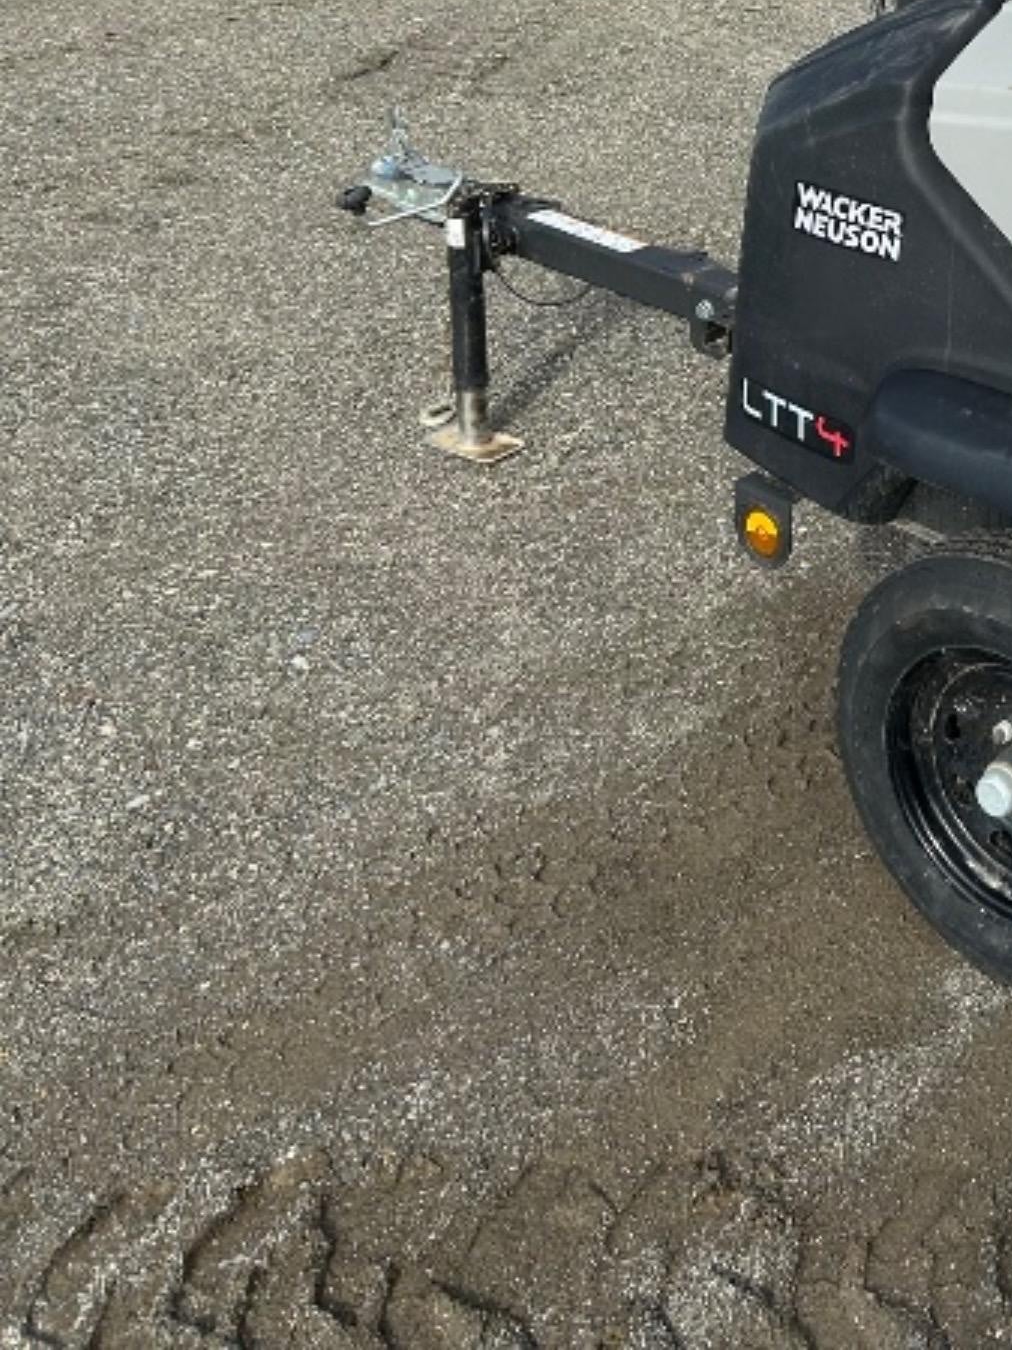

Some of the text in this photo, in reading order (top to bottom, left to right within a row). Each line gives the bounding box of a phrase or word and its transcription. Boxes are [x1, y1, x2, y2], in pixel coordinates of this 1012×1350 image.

[794, 206, 901, 262] NEUSON
[795, 181, 904, 238] WACKER
[742, 377, 849, 457] LTT4
